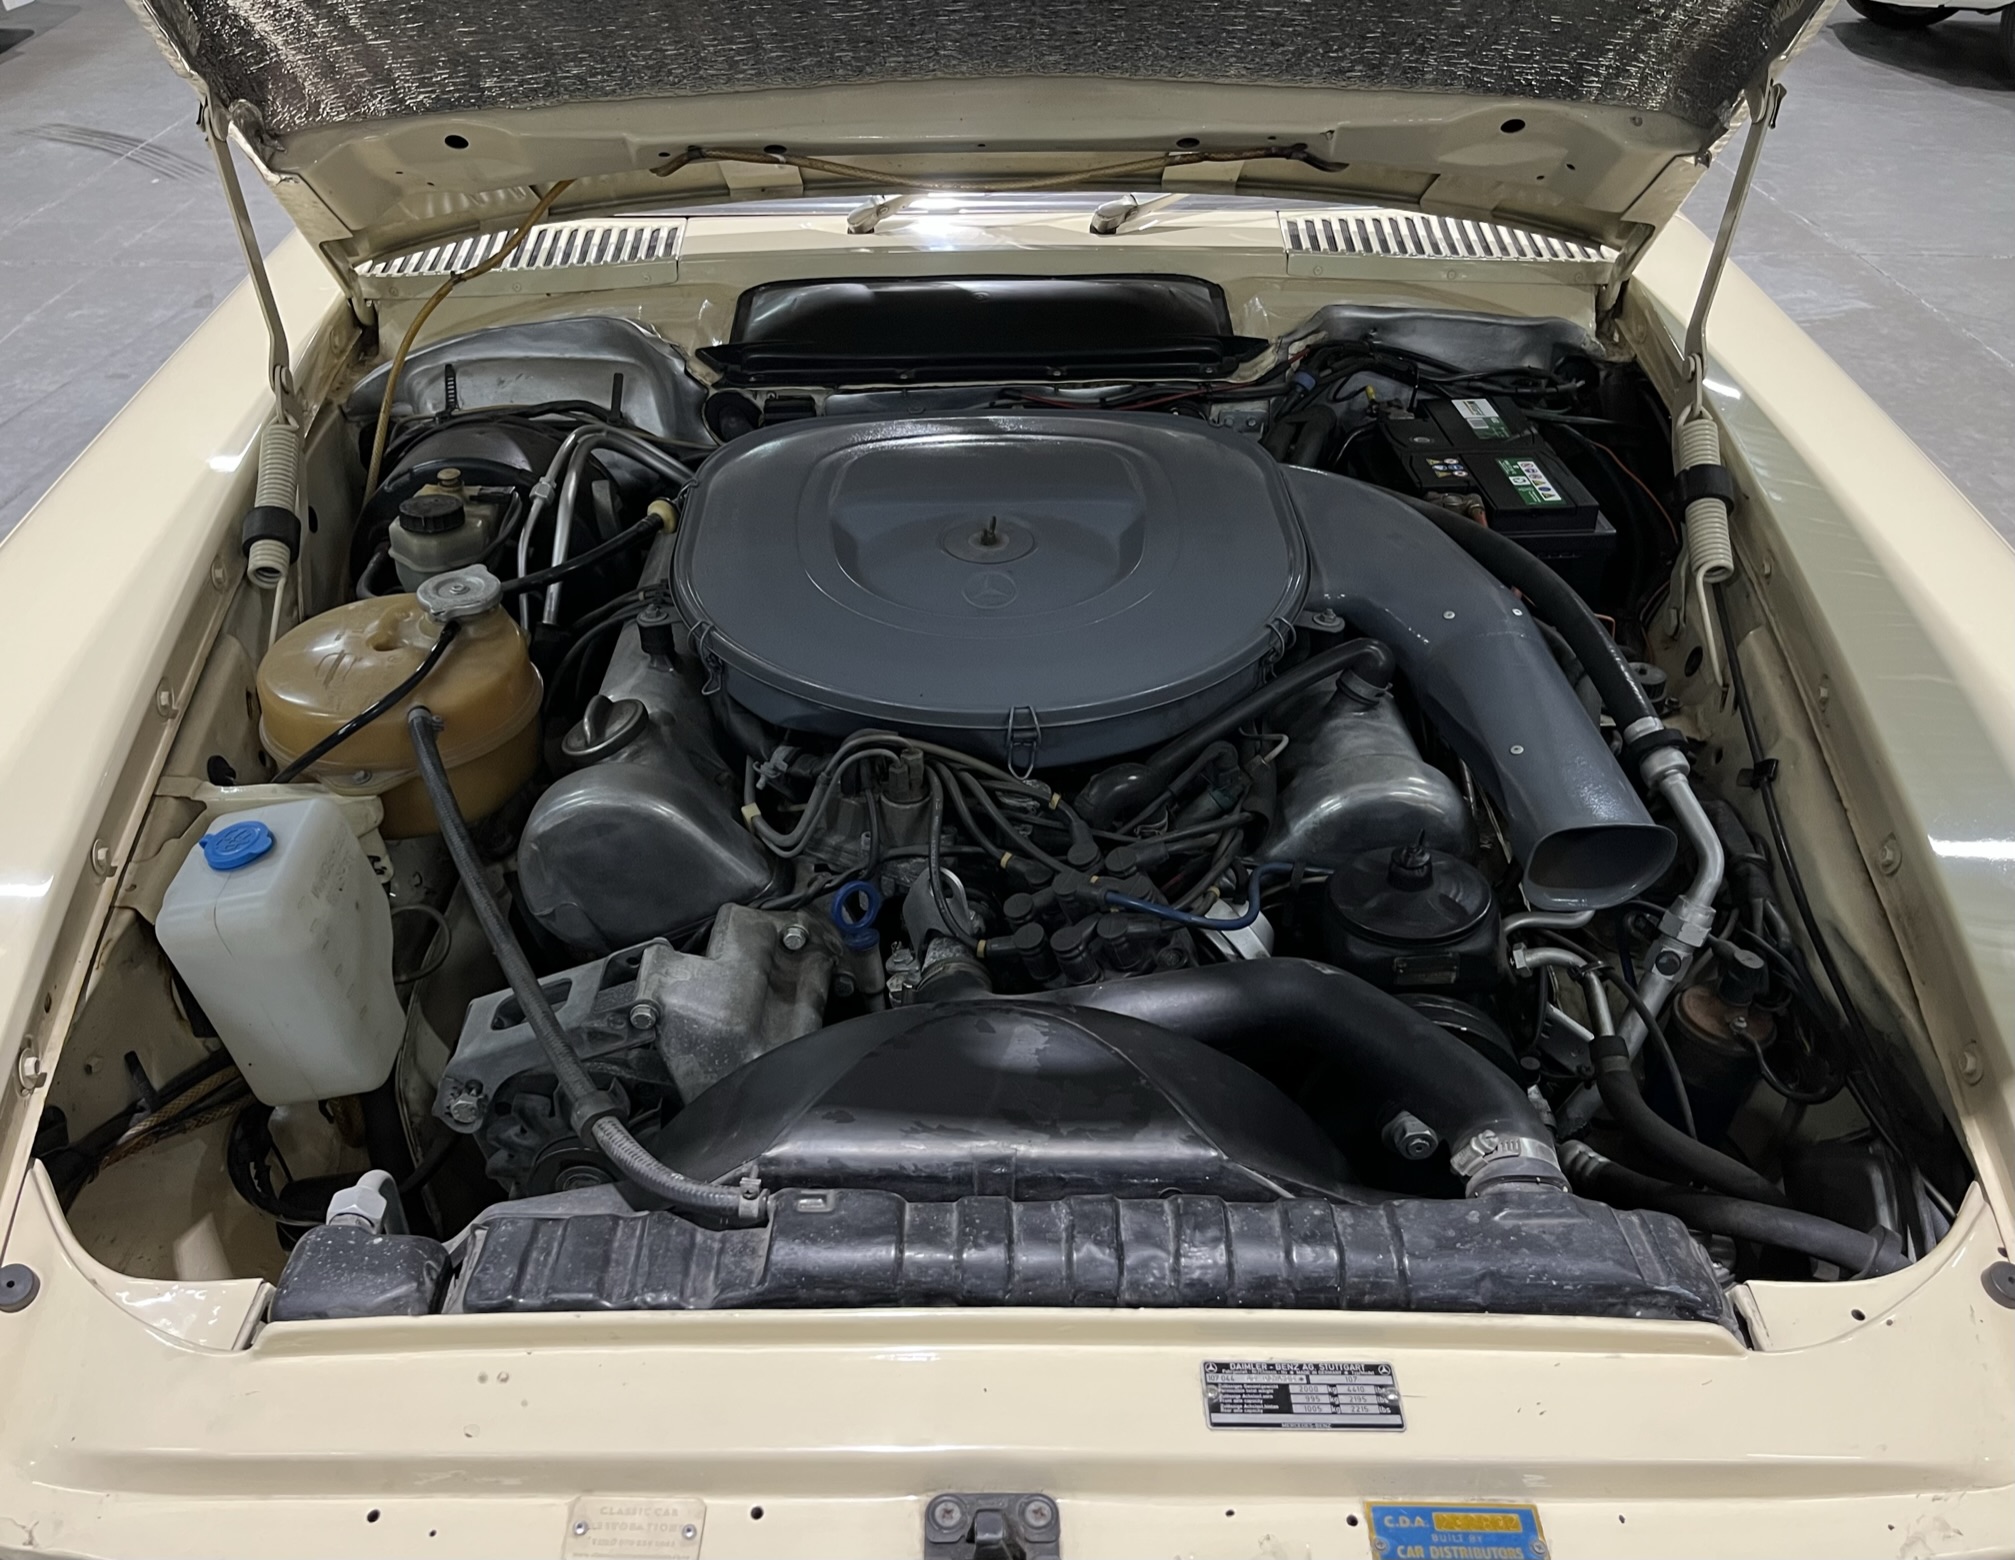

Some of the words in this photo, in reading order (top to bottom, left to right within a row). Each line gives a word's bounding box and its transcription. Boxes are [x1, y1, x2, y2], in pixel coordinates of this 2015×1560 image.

[1328, 1386, 1337, 1394] kg
[1330, 1396, 1339, 1404] kg
[1331, 1406, 1341, 1414] kg
[600, 1506, 652, 1517] CLASSIC
[654, 1507, 679, 1517] CAR
[1384, 1515, 1429, 1528] C.D.A.
[1431, 1533, 1464, 1543] BUILT
[1469, 1534, 1483, 1543] BY
[1396, 1545, 1425, 1558] CAR
[1430, 1546, 1523, 1560] DISTRIBUTORS
